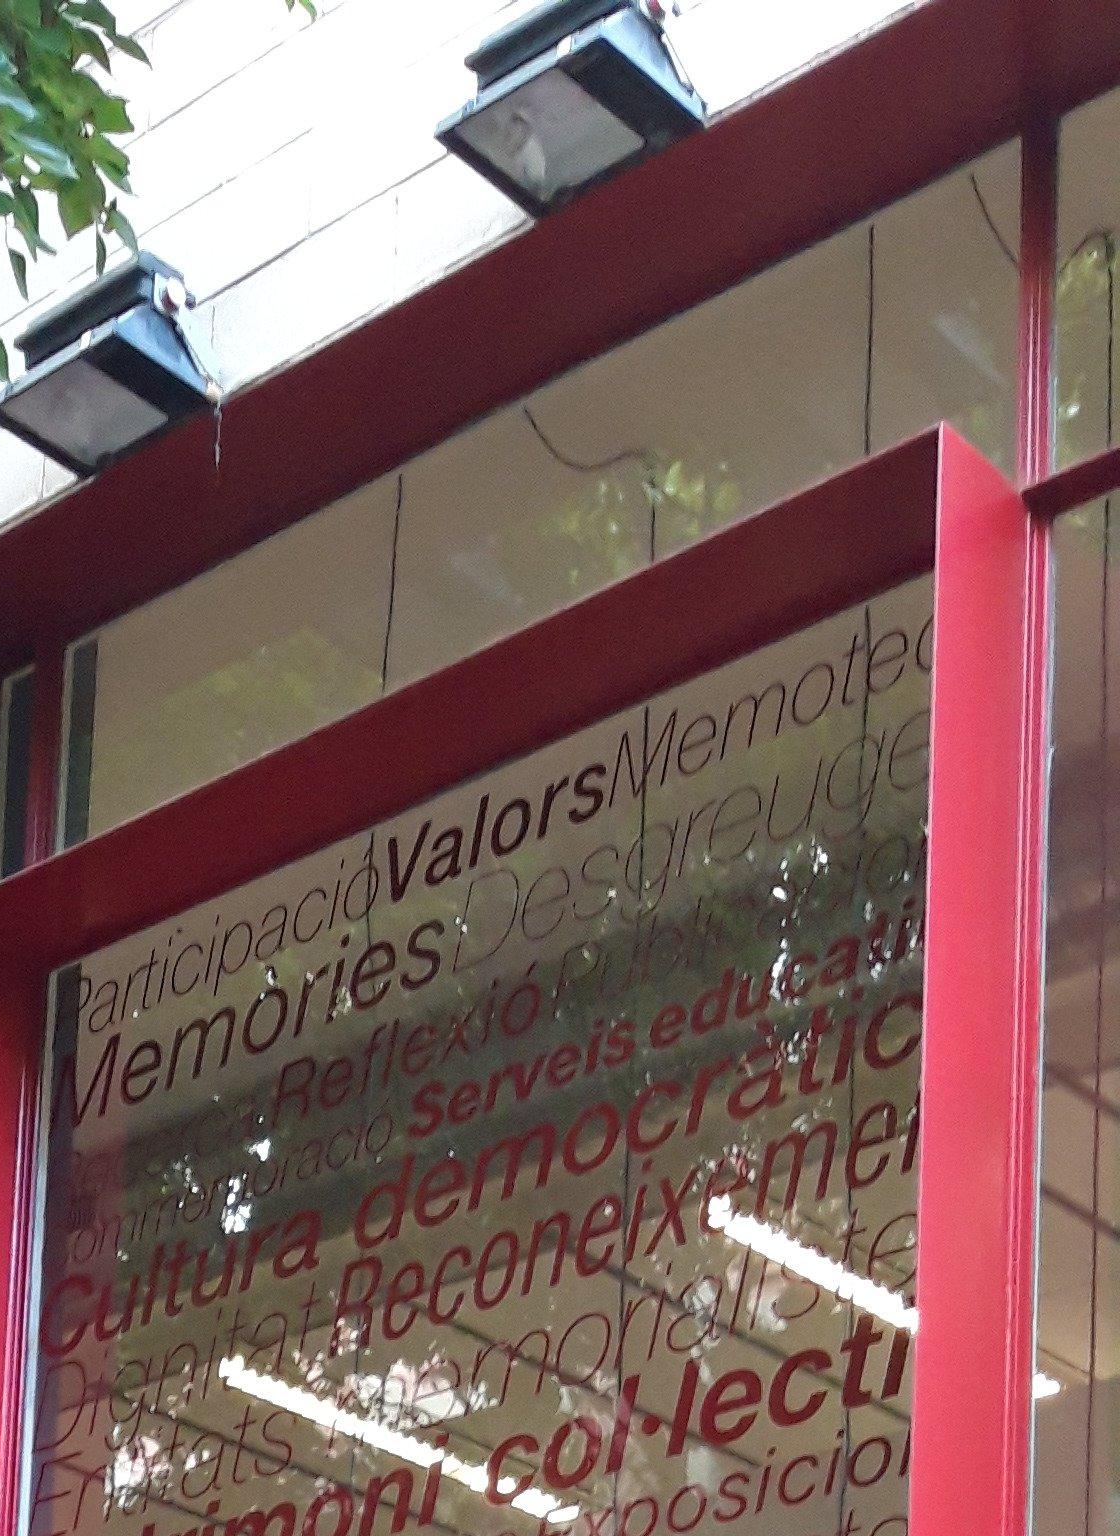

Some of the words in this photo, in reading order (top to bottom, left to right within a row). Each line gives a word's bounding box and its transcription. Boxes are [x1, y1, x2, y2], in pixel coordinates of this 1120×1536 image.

[383, 759, 611, 906] Valors
[46, 920, 444, 1127] Memòries
[272, 960, 541, 1129] Reflexió
[406, 1016, 636, 1139] Serveis
[39, 1207, 323, 1357] Cultura
[354, 986, 923, 1249] democràtic
[34, 1280, 318, 1452] Dignitat
